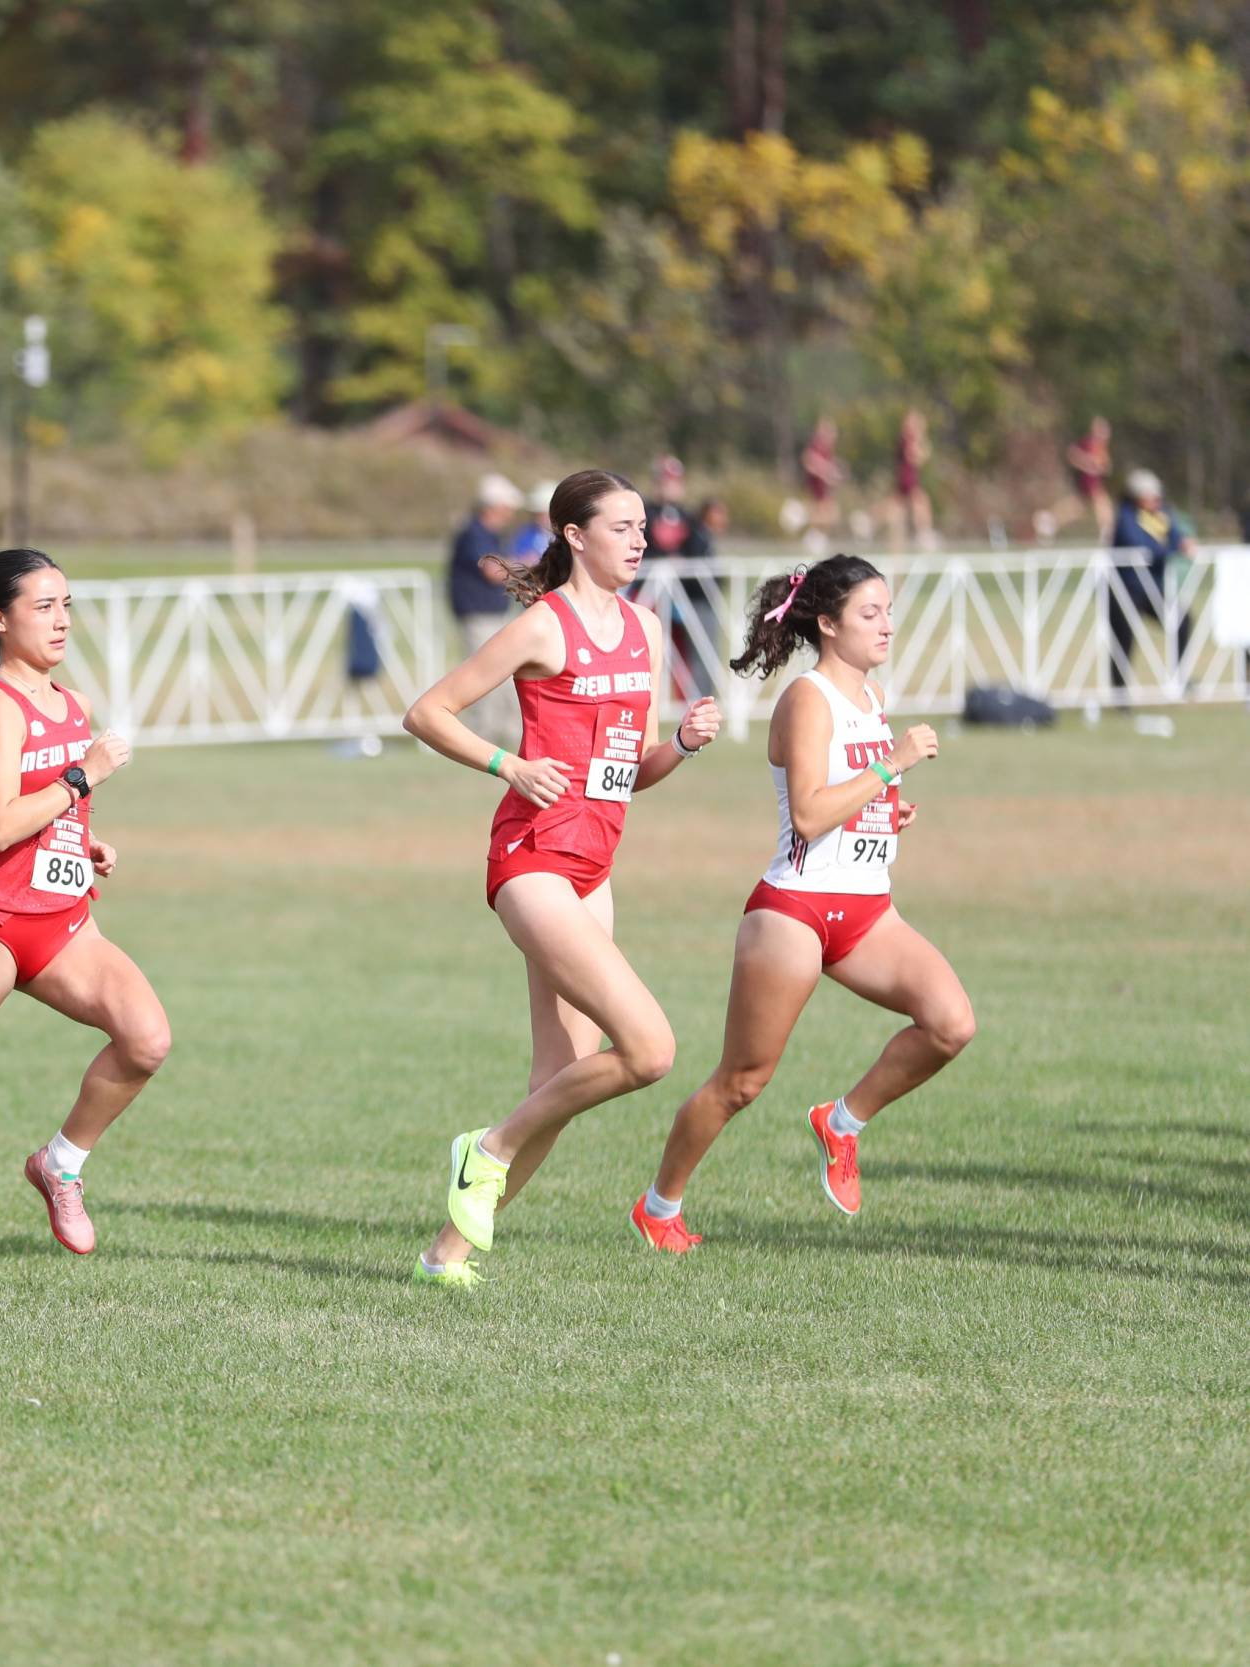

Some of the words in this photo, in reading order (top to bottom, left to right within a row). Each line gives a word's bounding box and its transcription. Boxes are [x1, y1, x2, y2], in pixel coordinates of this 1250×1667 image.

[572, 674, 611, 697] NEW
[21, 744, 65, 773] NEW
[844, 739, 894, 770] UTA
[602, 765, 633, 793] 844
[853, 838, 888, 864] 974
[46, 857, 85, 888] 850
